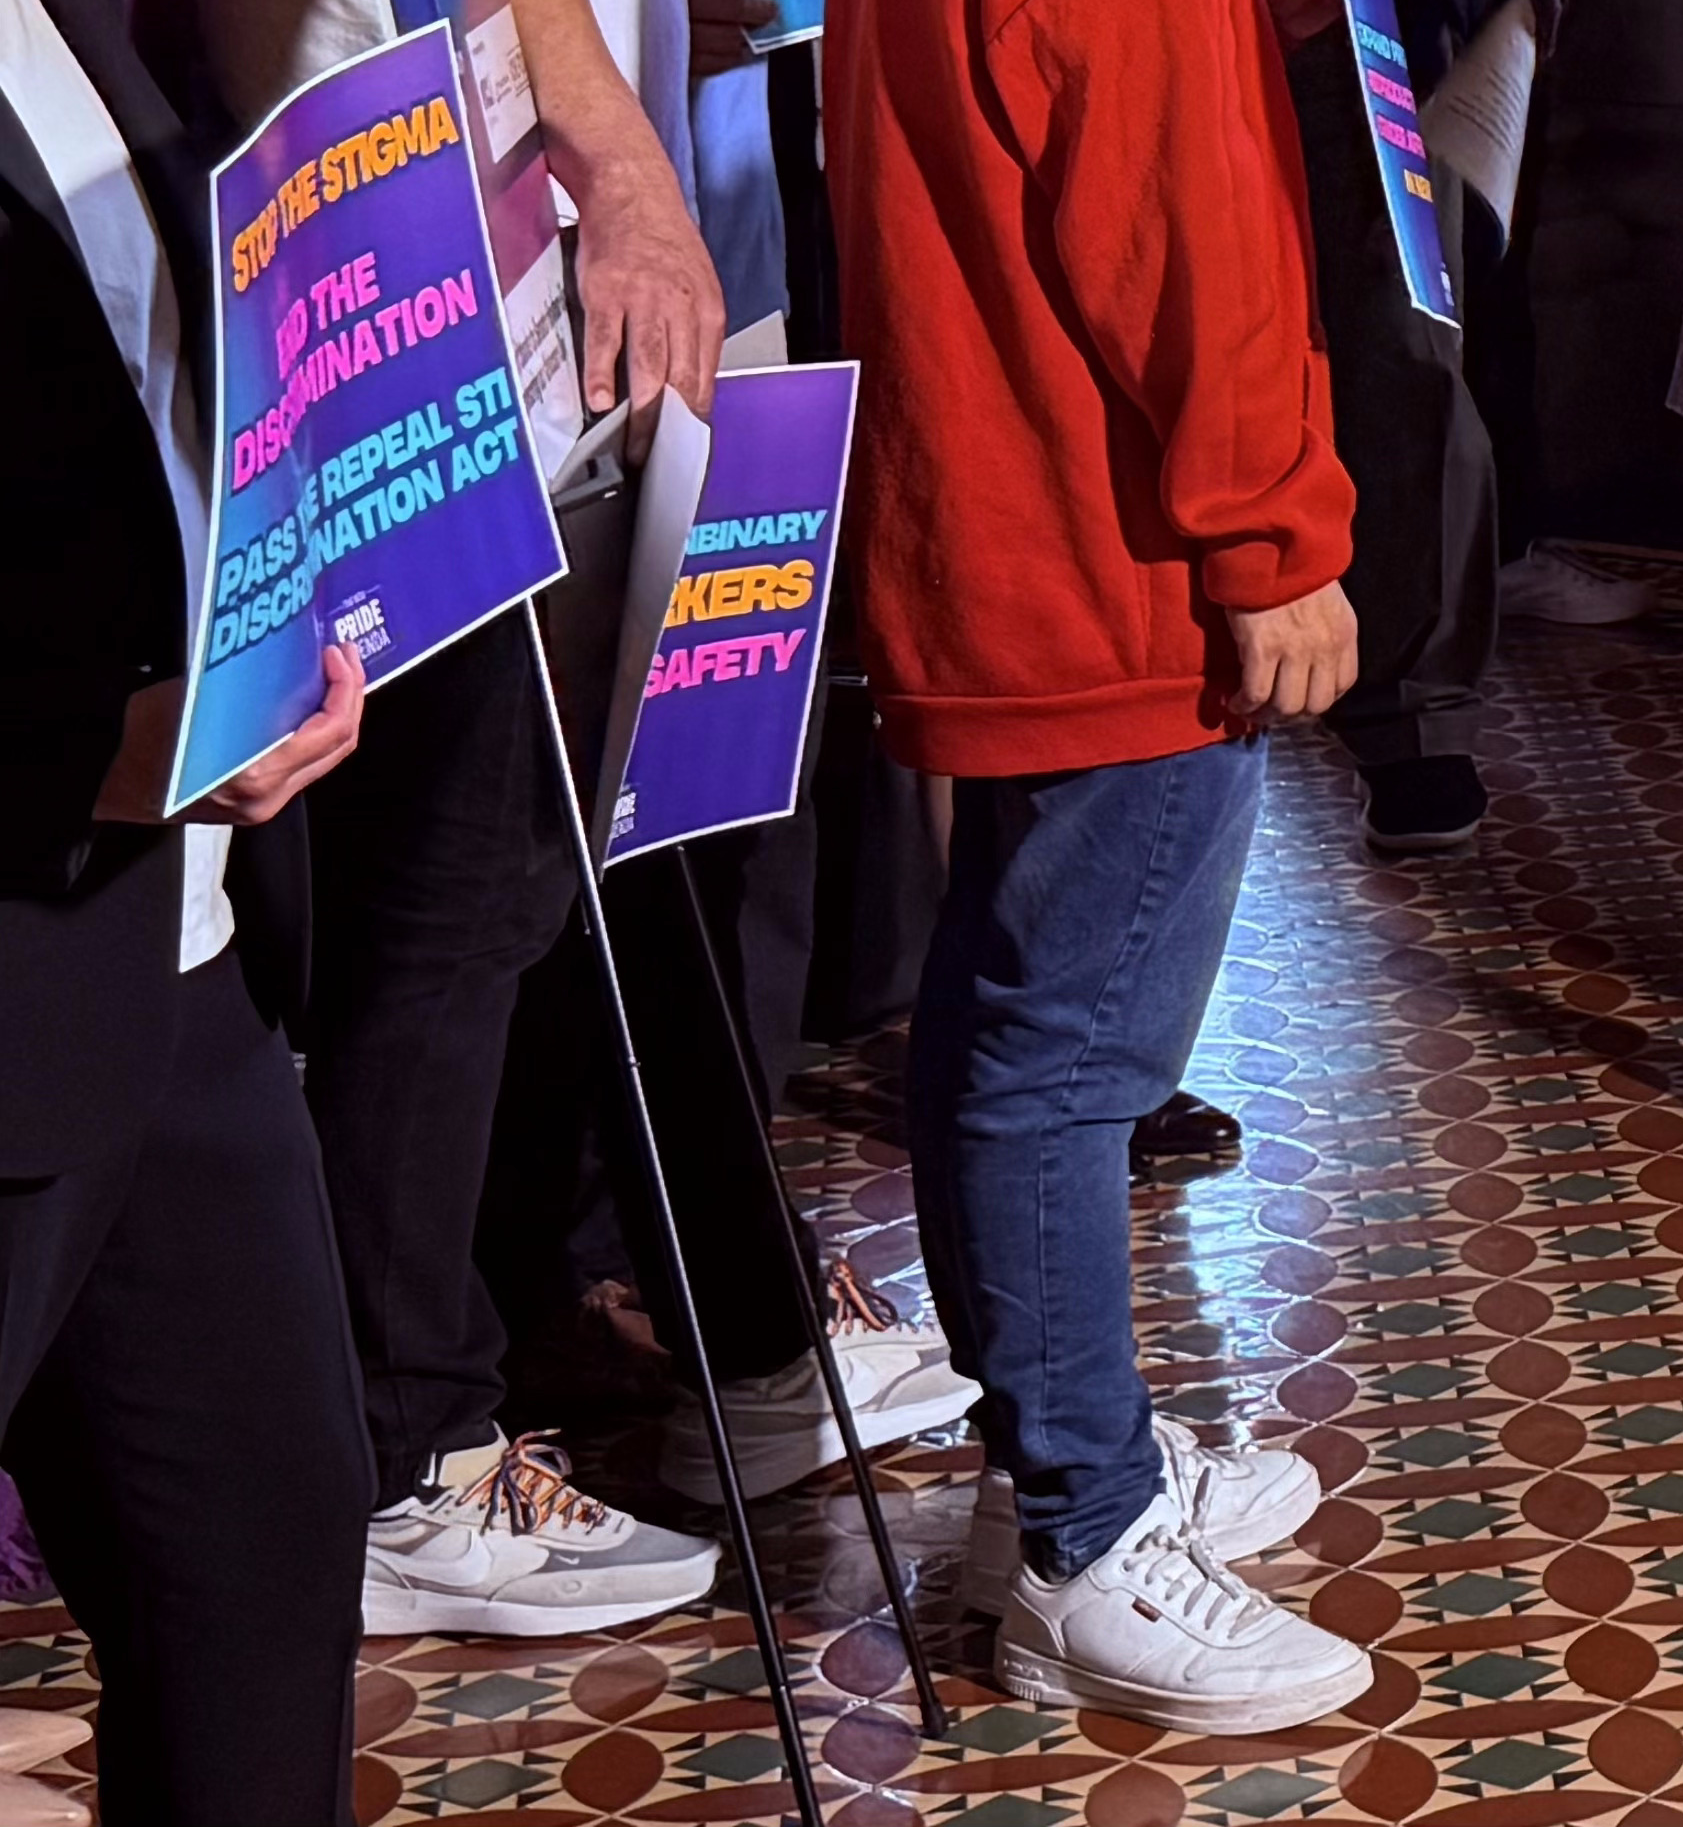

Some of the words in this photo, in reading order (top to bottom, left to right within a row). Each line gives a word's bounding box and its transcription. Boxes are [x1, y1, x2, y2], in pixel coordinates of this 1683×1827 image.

[231, 198, 278, 293] STOP
[277, 159, 321, 239] THE
[320, 95, 460, 203] STIGMA
[309, 251, 381, 332] THE
[216, 519, 296, 609] PASS
[321, 400, 455, 508] REPEAL
[455, 366, 513, 429] STI
[451, 415, 520, 494] ACT
[686, 509, 828, 556] NBINARY
[334, 597, 385, 644] PRIDE
[663, 559, 815, 629] KERS
[357, 626, 392, 660] ENDA
[643, 628, 807, 699] SAFETY
